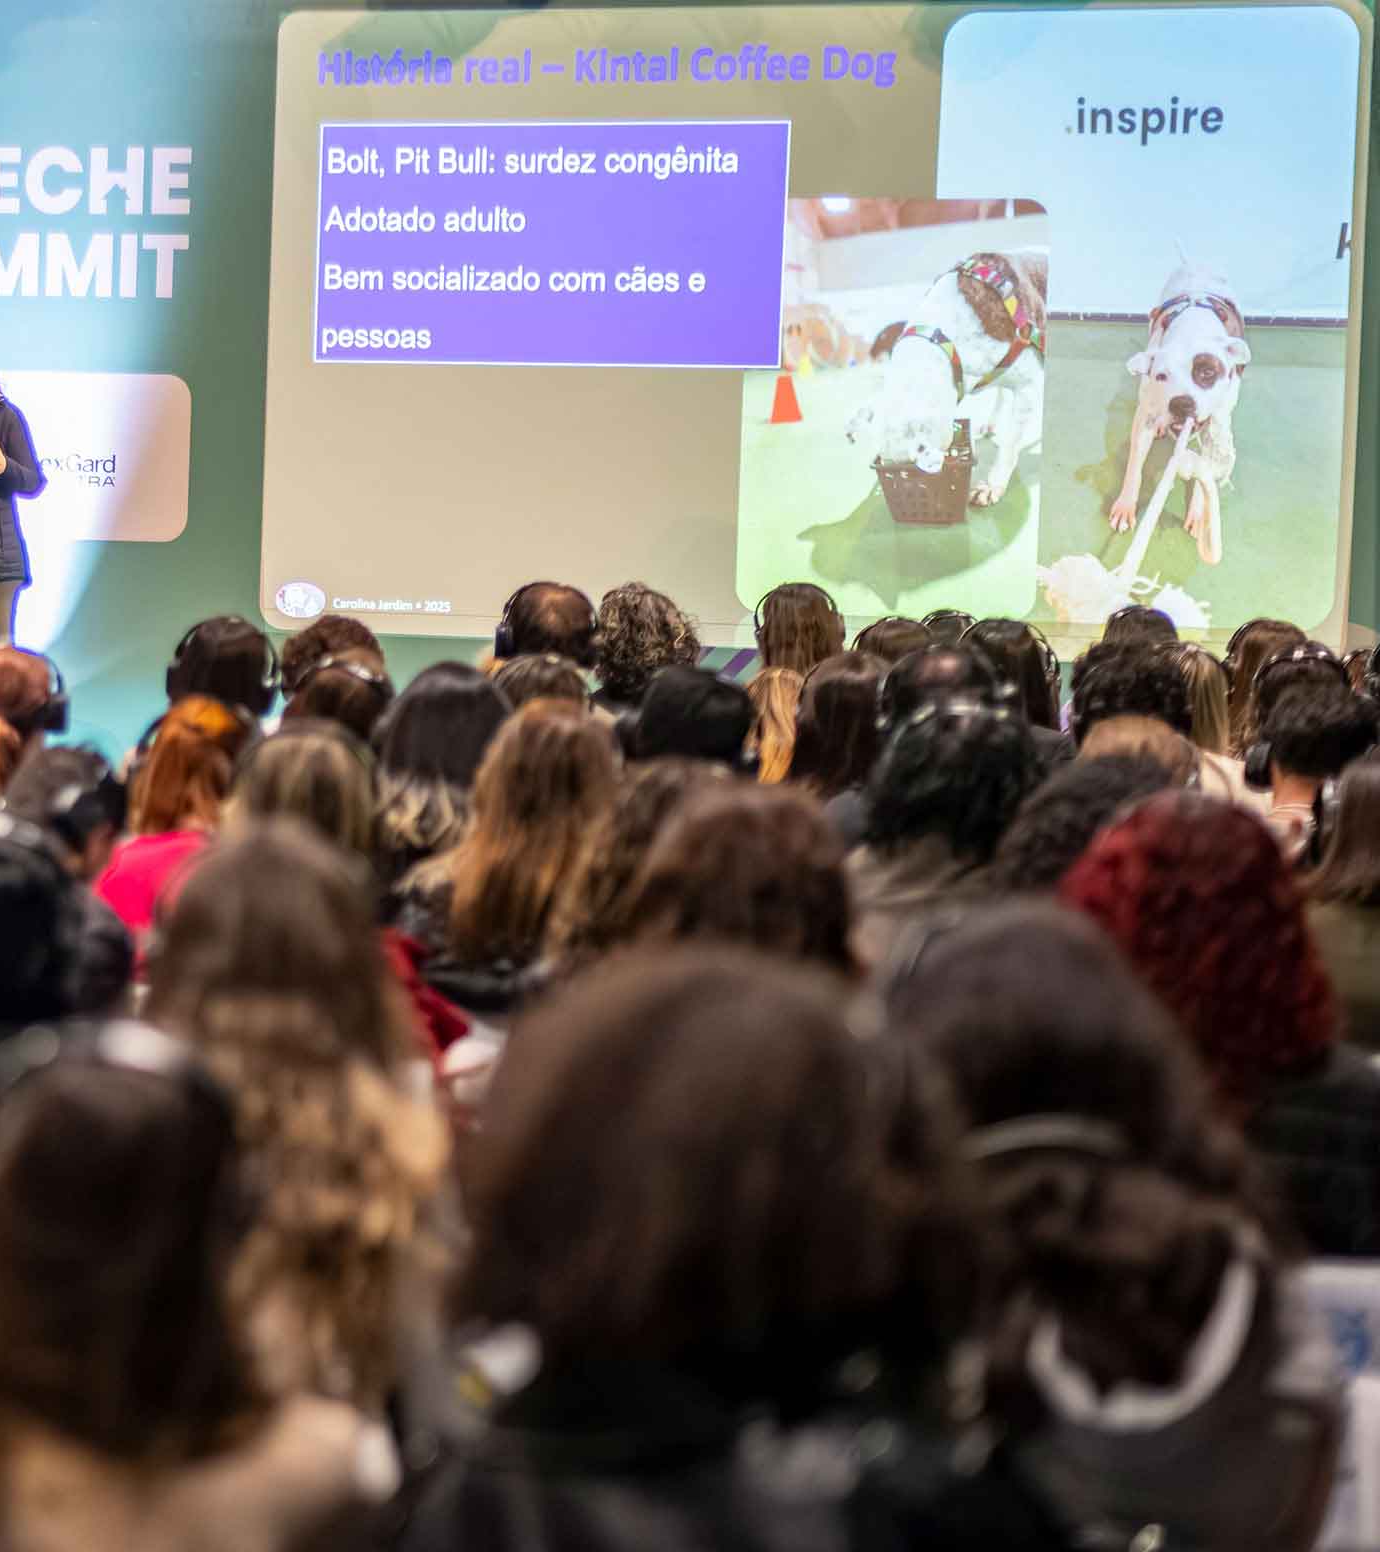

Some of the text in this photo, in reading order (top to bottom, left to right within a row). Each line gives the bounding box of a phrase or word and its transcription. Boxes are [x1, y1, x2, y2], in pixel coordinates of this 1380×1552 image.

[317, 46, 453, 85] História
[463, 48, 532, 84] real
[574, 47, 679, 84] Kintal
[689, 43, 811, 83] Coffee
[822, 45, 897, 88] Dog
[327, 145, 739, 180] Bolt, Pit Bull: surdez congênita
[324, 205, 526, 233] Adotado adulto
[323, 263, 706, 293] Bem socializado com cães e
[321, 327, 432, 353] pessoas
